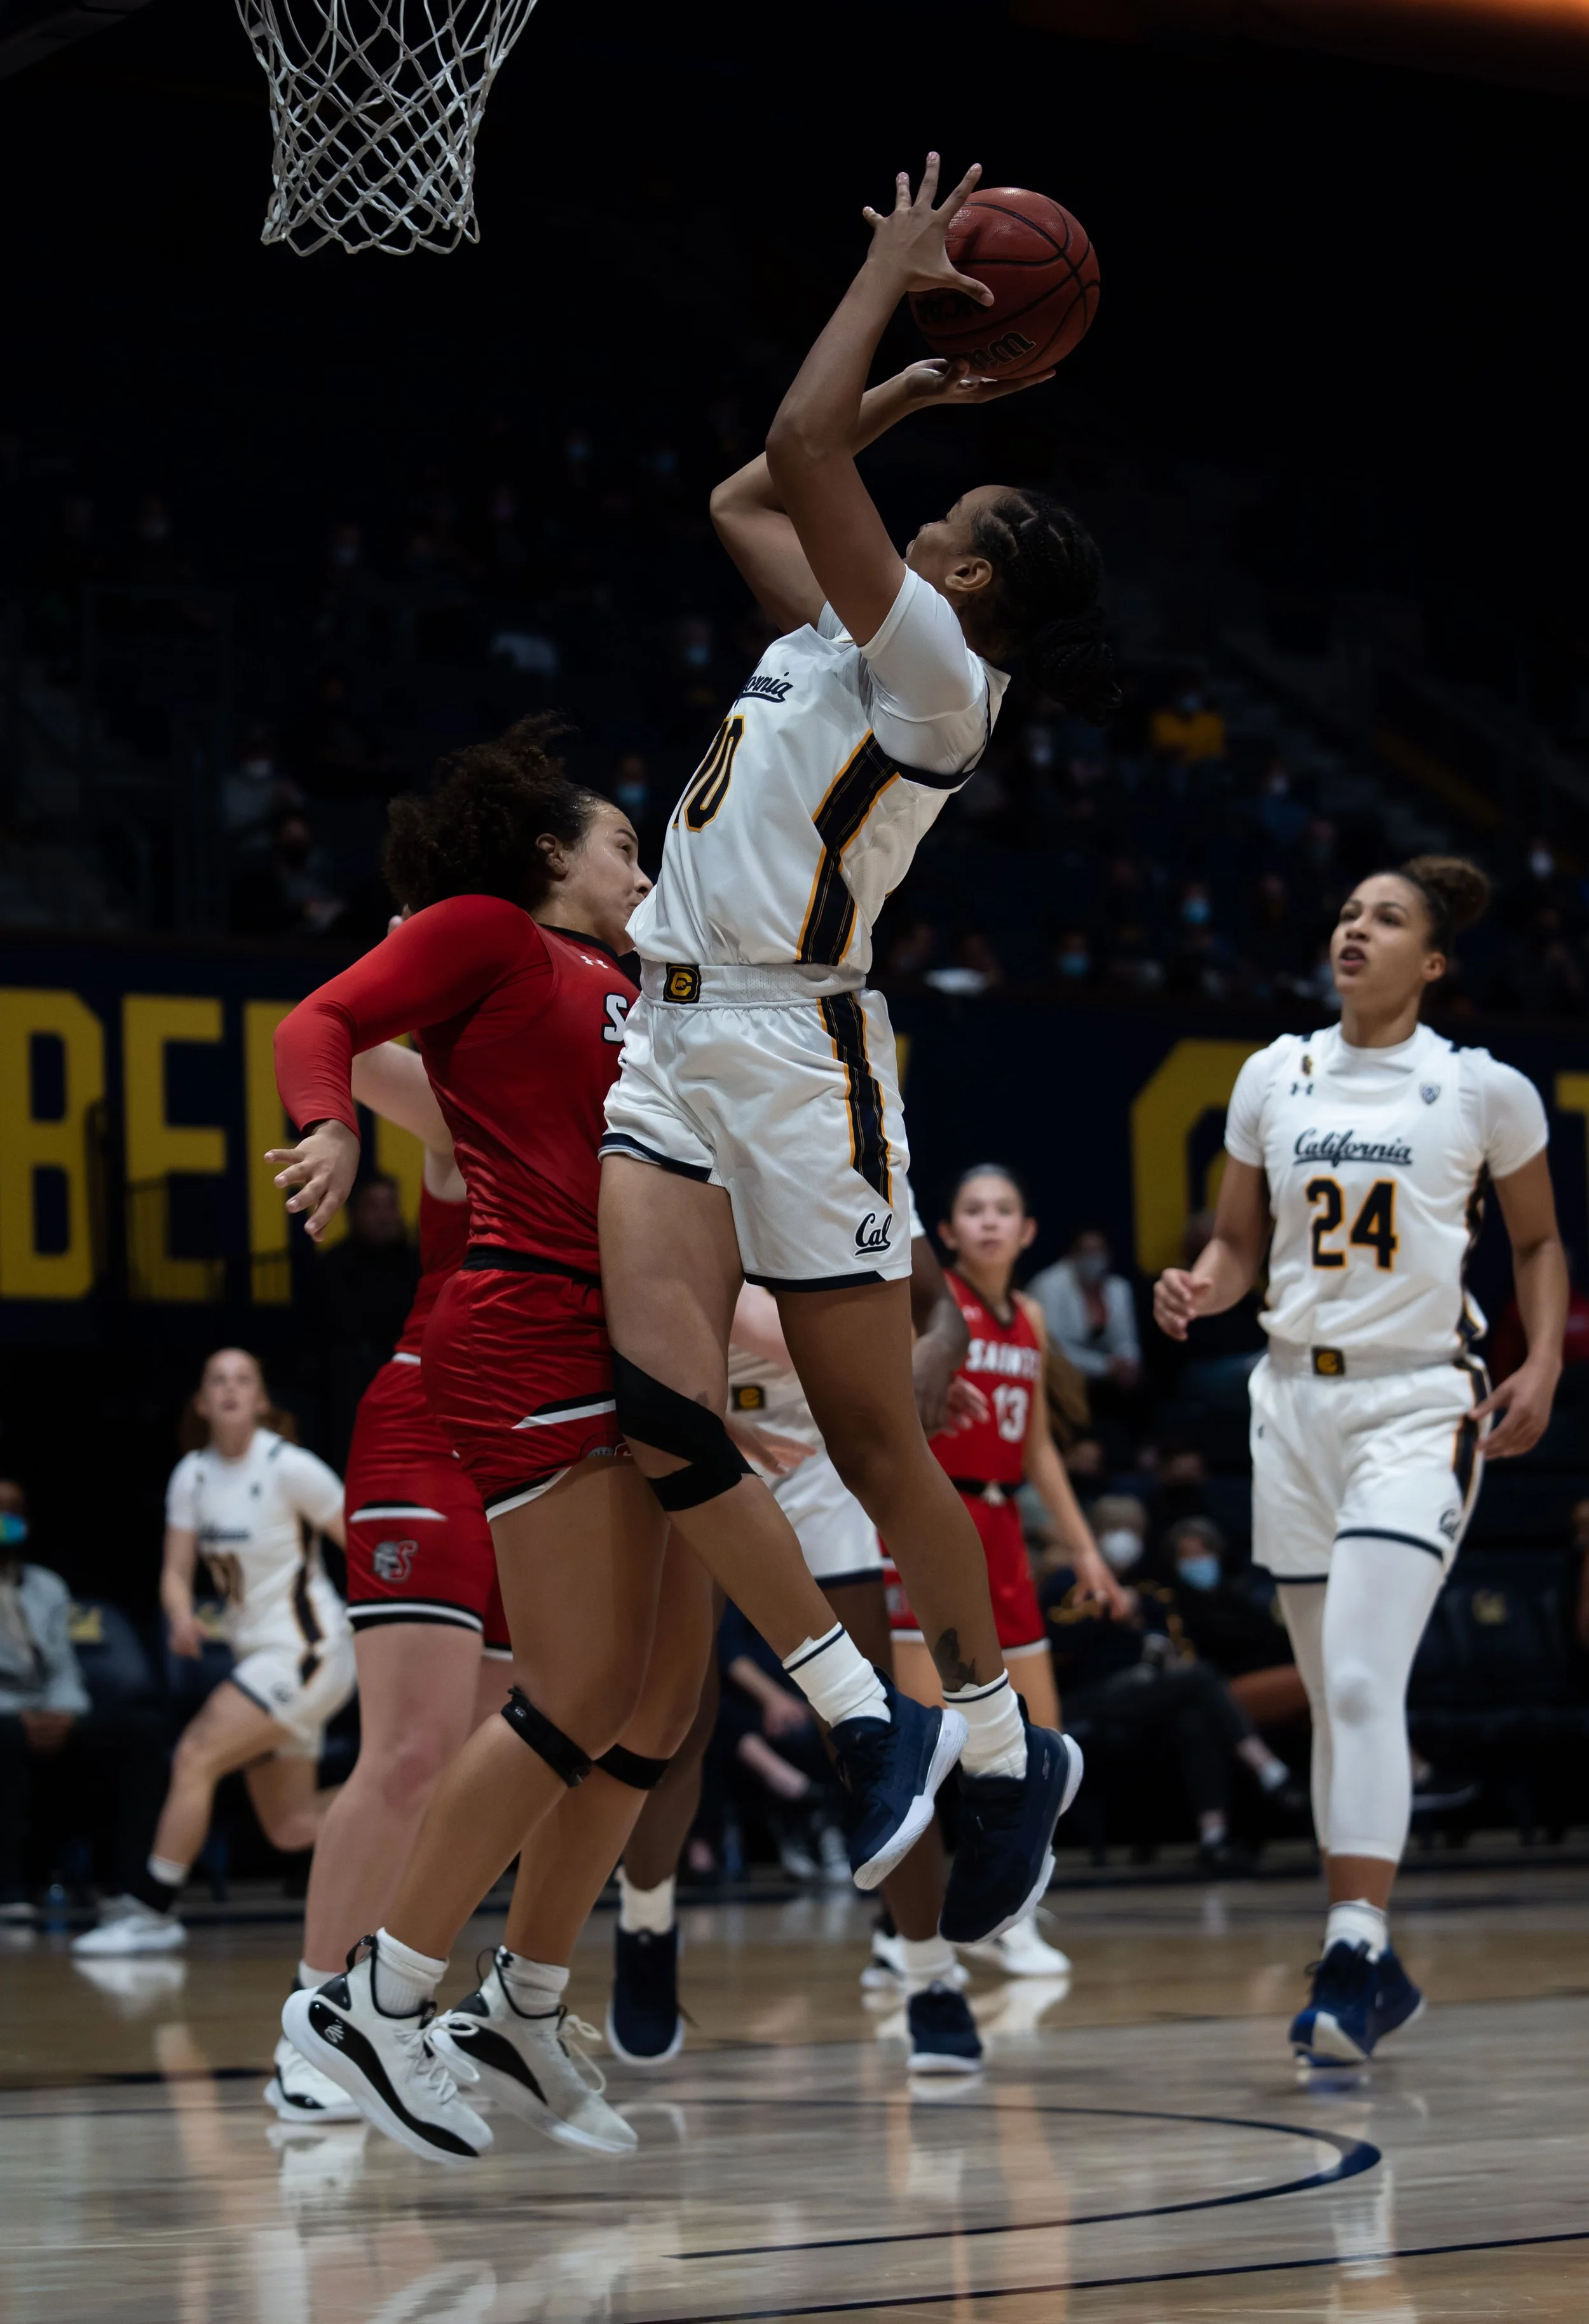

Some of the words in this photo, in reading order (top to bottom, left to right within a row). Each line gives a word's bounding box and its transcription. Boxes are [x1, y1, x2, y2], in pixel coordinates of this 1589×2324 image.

[1293, 1128, 1412, 1167] California
[854, 1212, 892, 1256] Cal
[1306, 1177, 1400, 1271] 24
[992, 1383, 1029, 1444] 13
